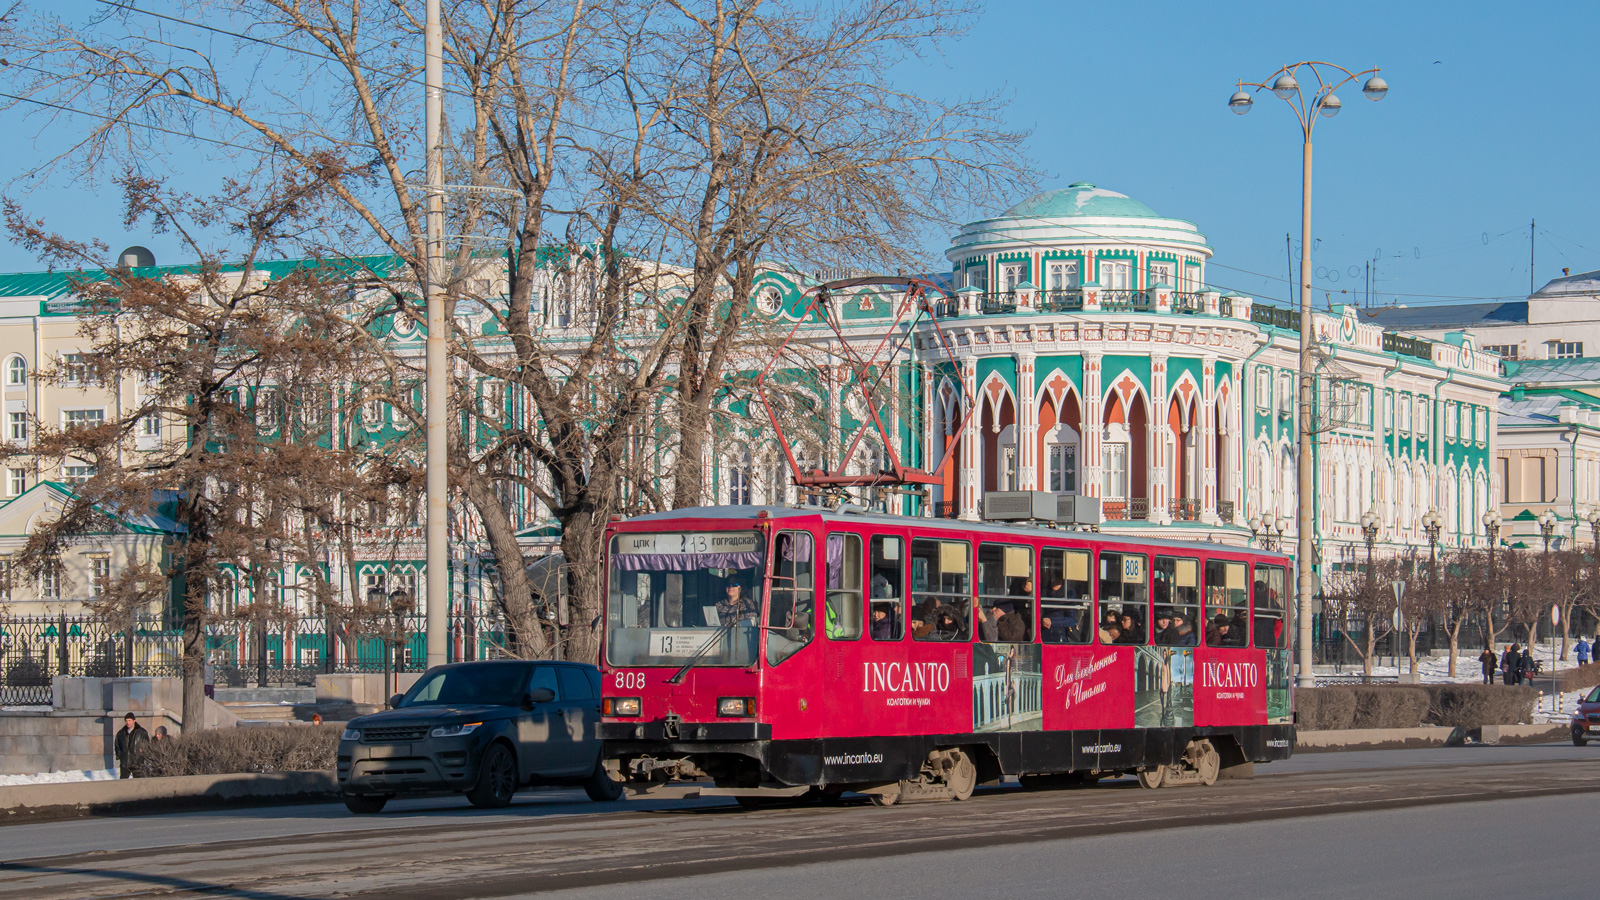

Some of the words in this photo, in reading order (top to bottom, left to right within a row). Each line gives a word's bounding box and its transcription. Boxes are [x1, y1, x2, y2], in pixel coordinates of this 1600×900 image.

[633, 539, 650, 549] ЦПК
[1125, 559, 1139, 576] 808
[660, 635, 673, 654] 13
[615, 671, 646, 689] 808
[863, 661, 950, 692] INCANTO
[1202, 662, 1258, 688] INCANTO
[823, 751, 883, 766] www.incanto.eu
